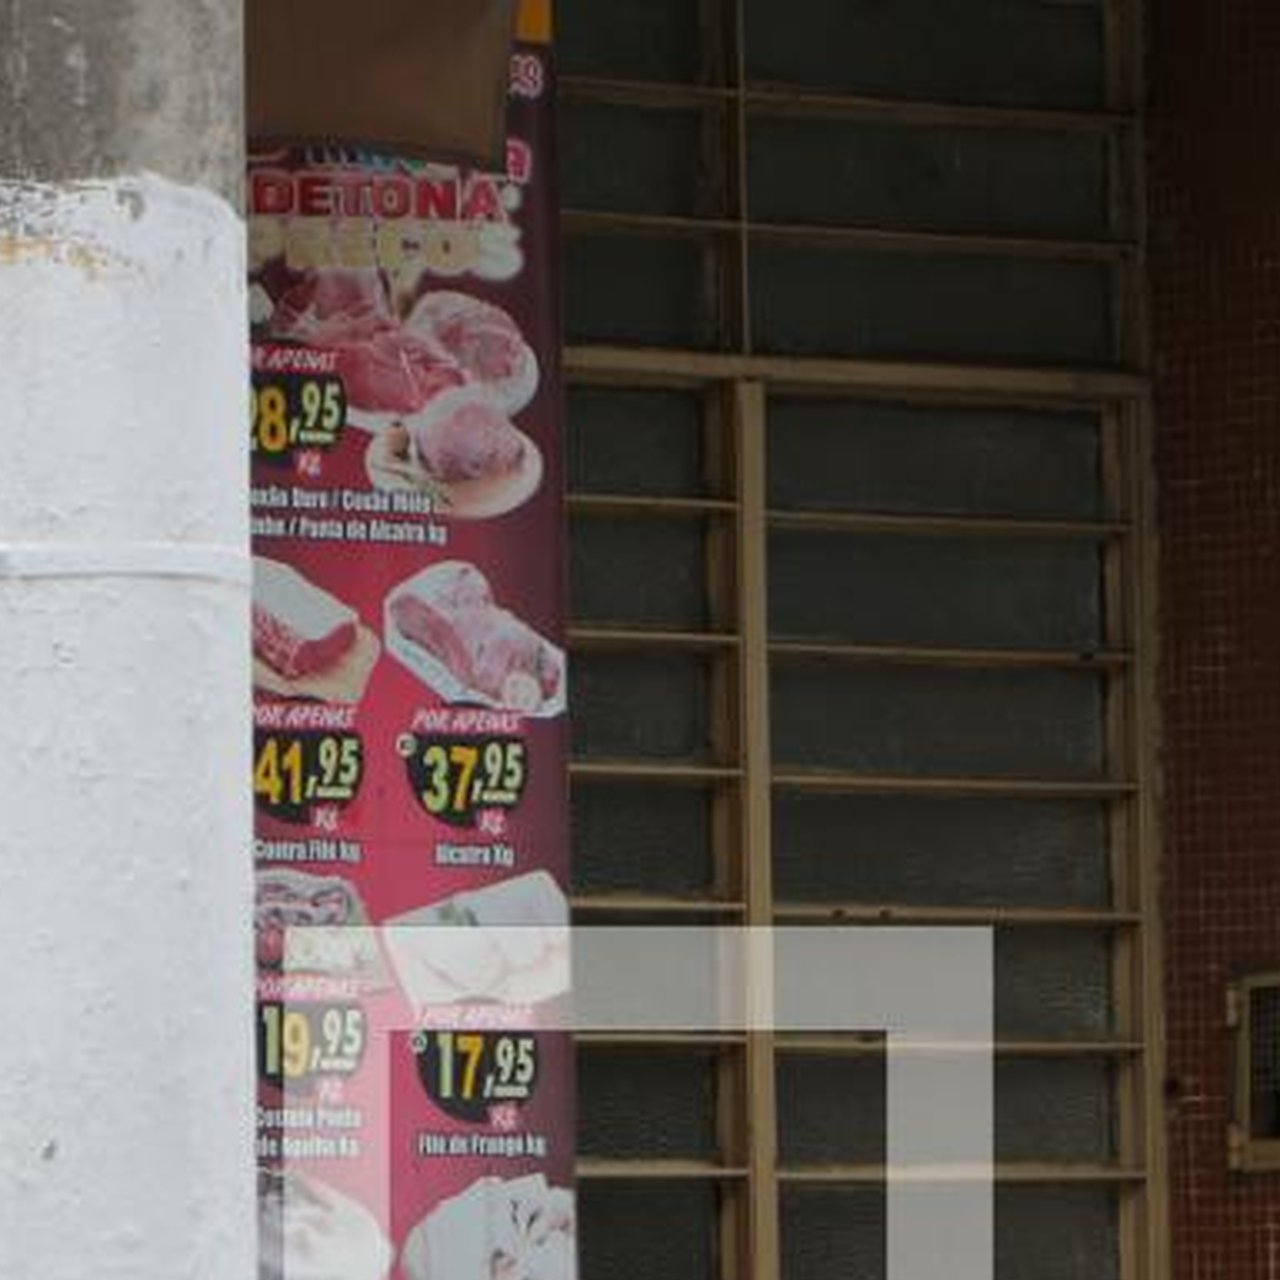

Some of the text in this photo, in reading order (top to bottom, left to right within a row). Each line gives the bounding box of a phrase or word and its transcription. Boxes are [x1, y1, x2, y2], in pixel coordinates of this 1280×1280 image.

[250, 168, 510, 222] DETONA
[255, 737, 360, 805] 41,95
[422, 742, 523, 813] 37,95
[262, 1005, 363, 1078] 19,95
[435, 1032, 535, 1100] 17,95
